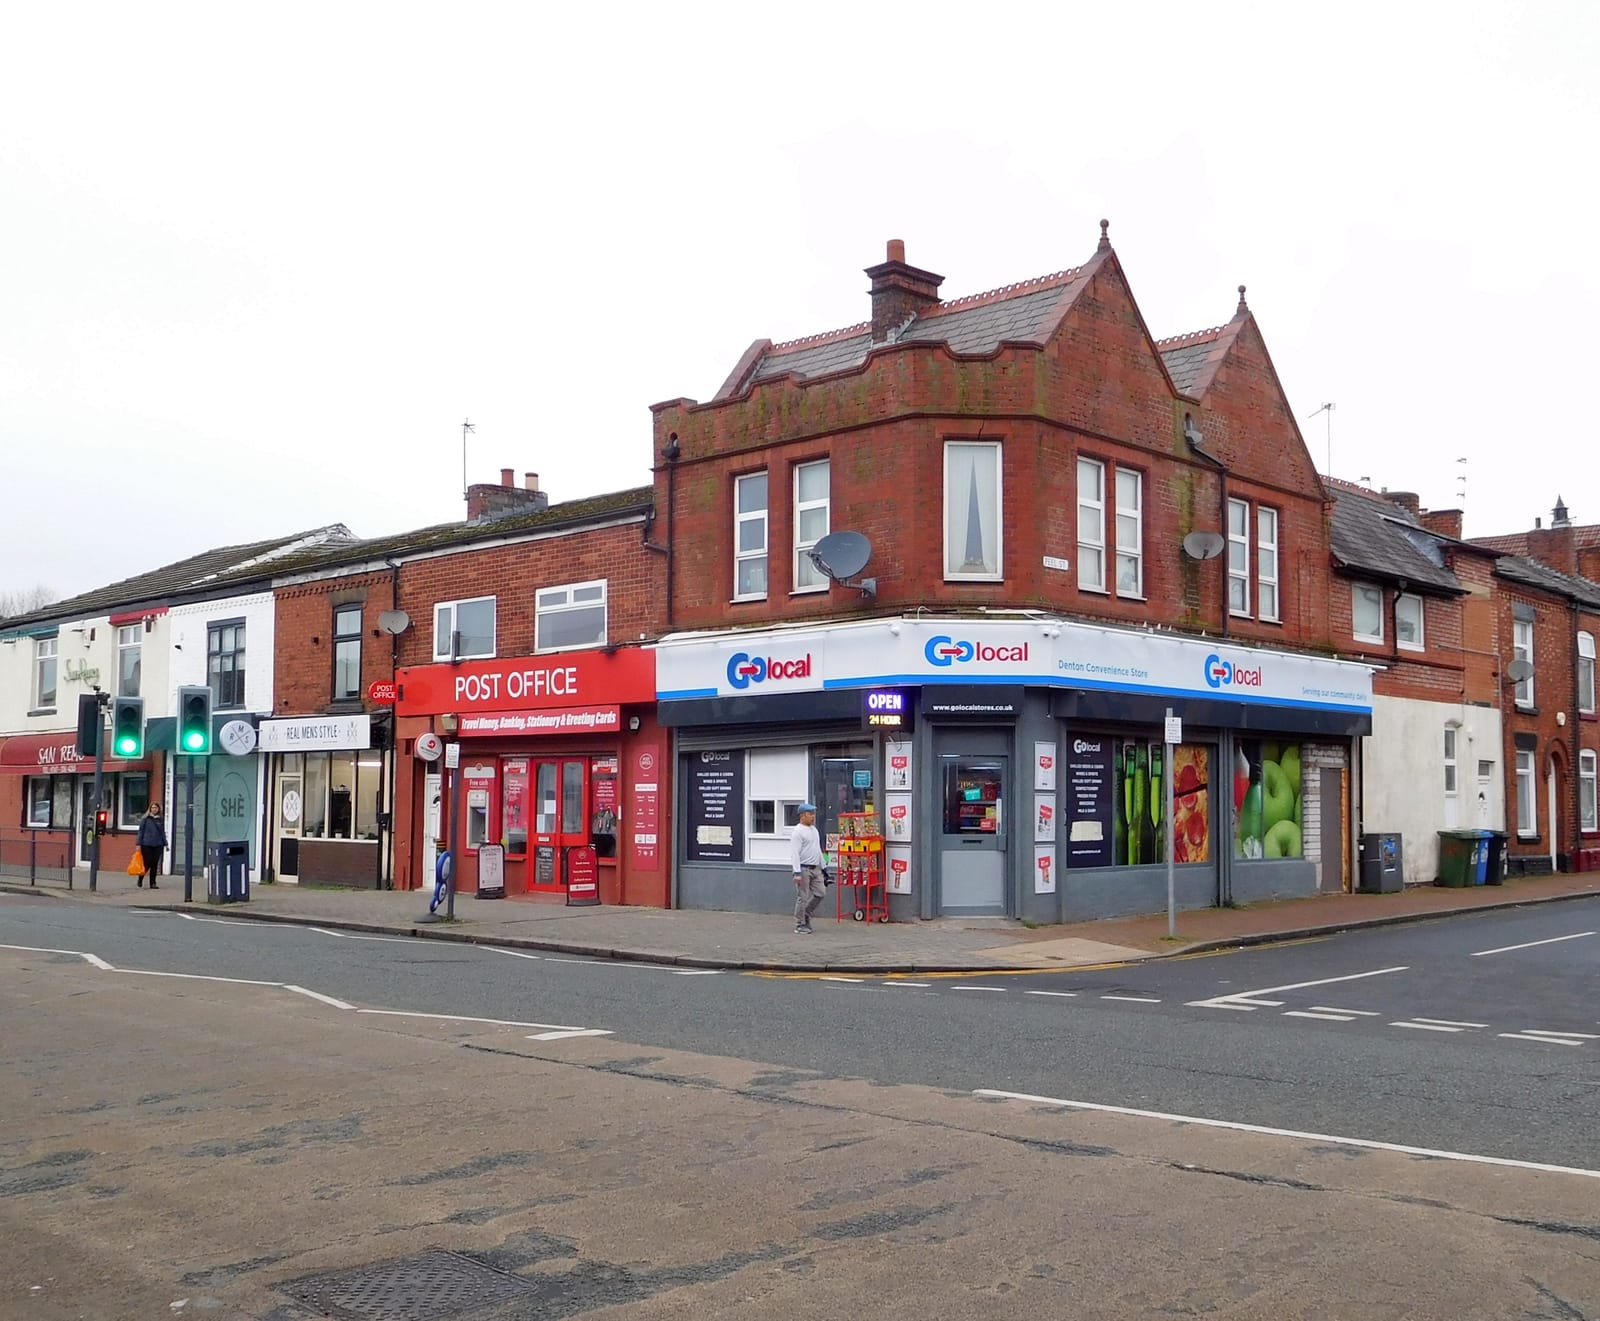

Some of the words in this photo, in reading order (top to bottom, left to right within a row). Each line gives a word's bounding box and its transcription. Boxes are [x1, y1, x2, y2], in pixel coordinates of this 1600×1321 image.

[1058, 660, 1084, 671] Denton
[1086, 663, 1129, 677] Convenience
[1130, 668, 1149, 679] Store
[455, 673, 501, 701] POST
[507, 667, 578, 698] OFFICE
[868, 694, 902, 709] OPEN
[461, 718, 479, 730] Travel
[479, 717, 499, 731] Money,
[499, 716, 525, 730] Banking,
[526, 714, 561, 728] Stationery
[560, 714, 566, 722] &
[566, 712, 595, 726] Greeting
[595, 710, 616, 724] Cards
[869, 715, 879, 725] 24
[880, 715, 901, 725] HOUR
[286, 727, 300, 740] REAL
[302, 726, 318, 739] MENS
[319, 724, 338, 738] STYLE
[37, 746, 56, 765] SAN
[220, 794, 245, 818] SHÈ
